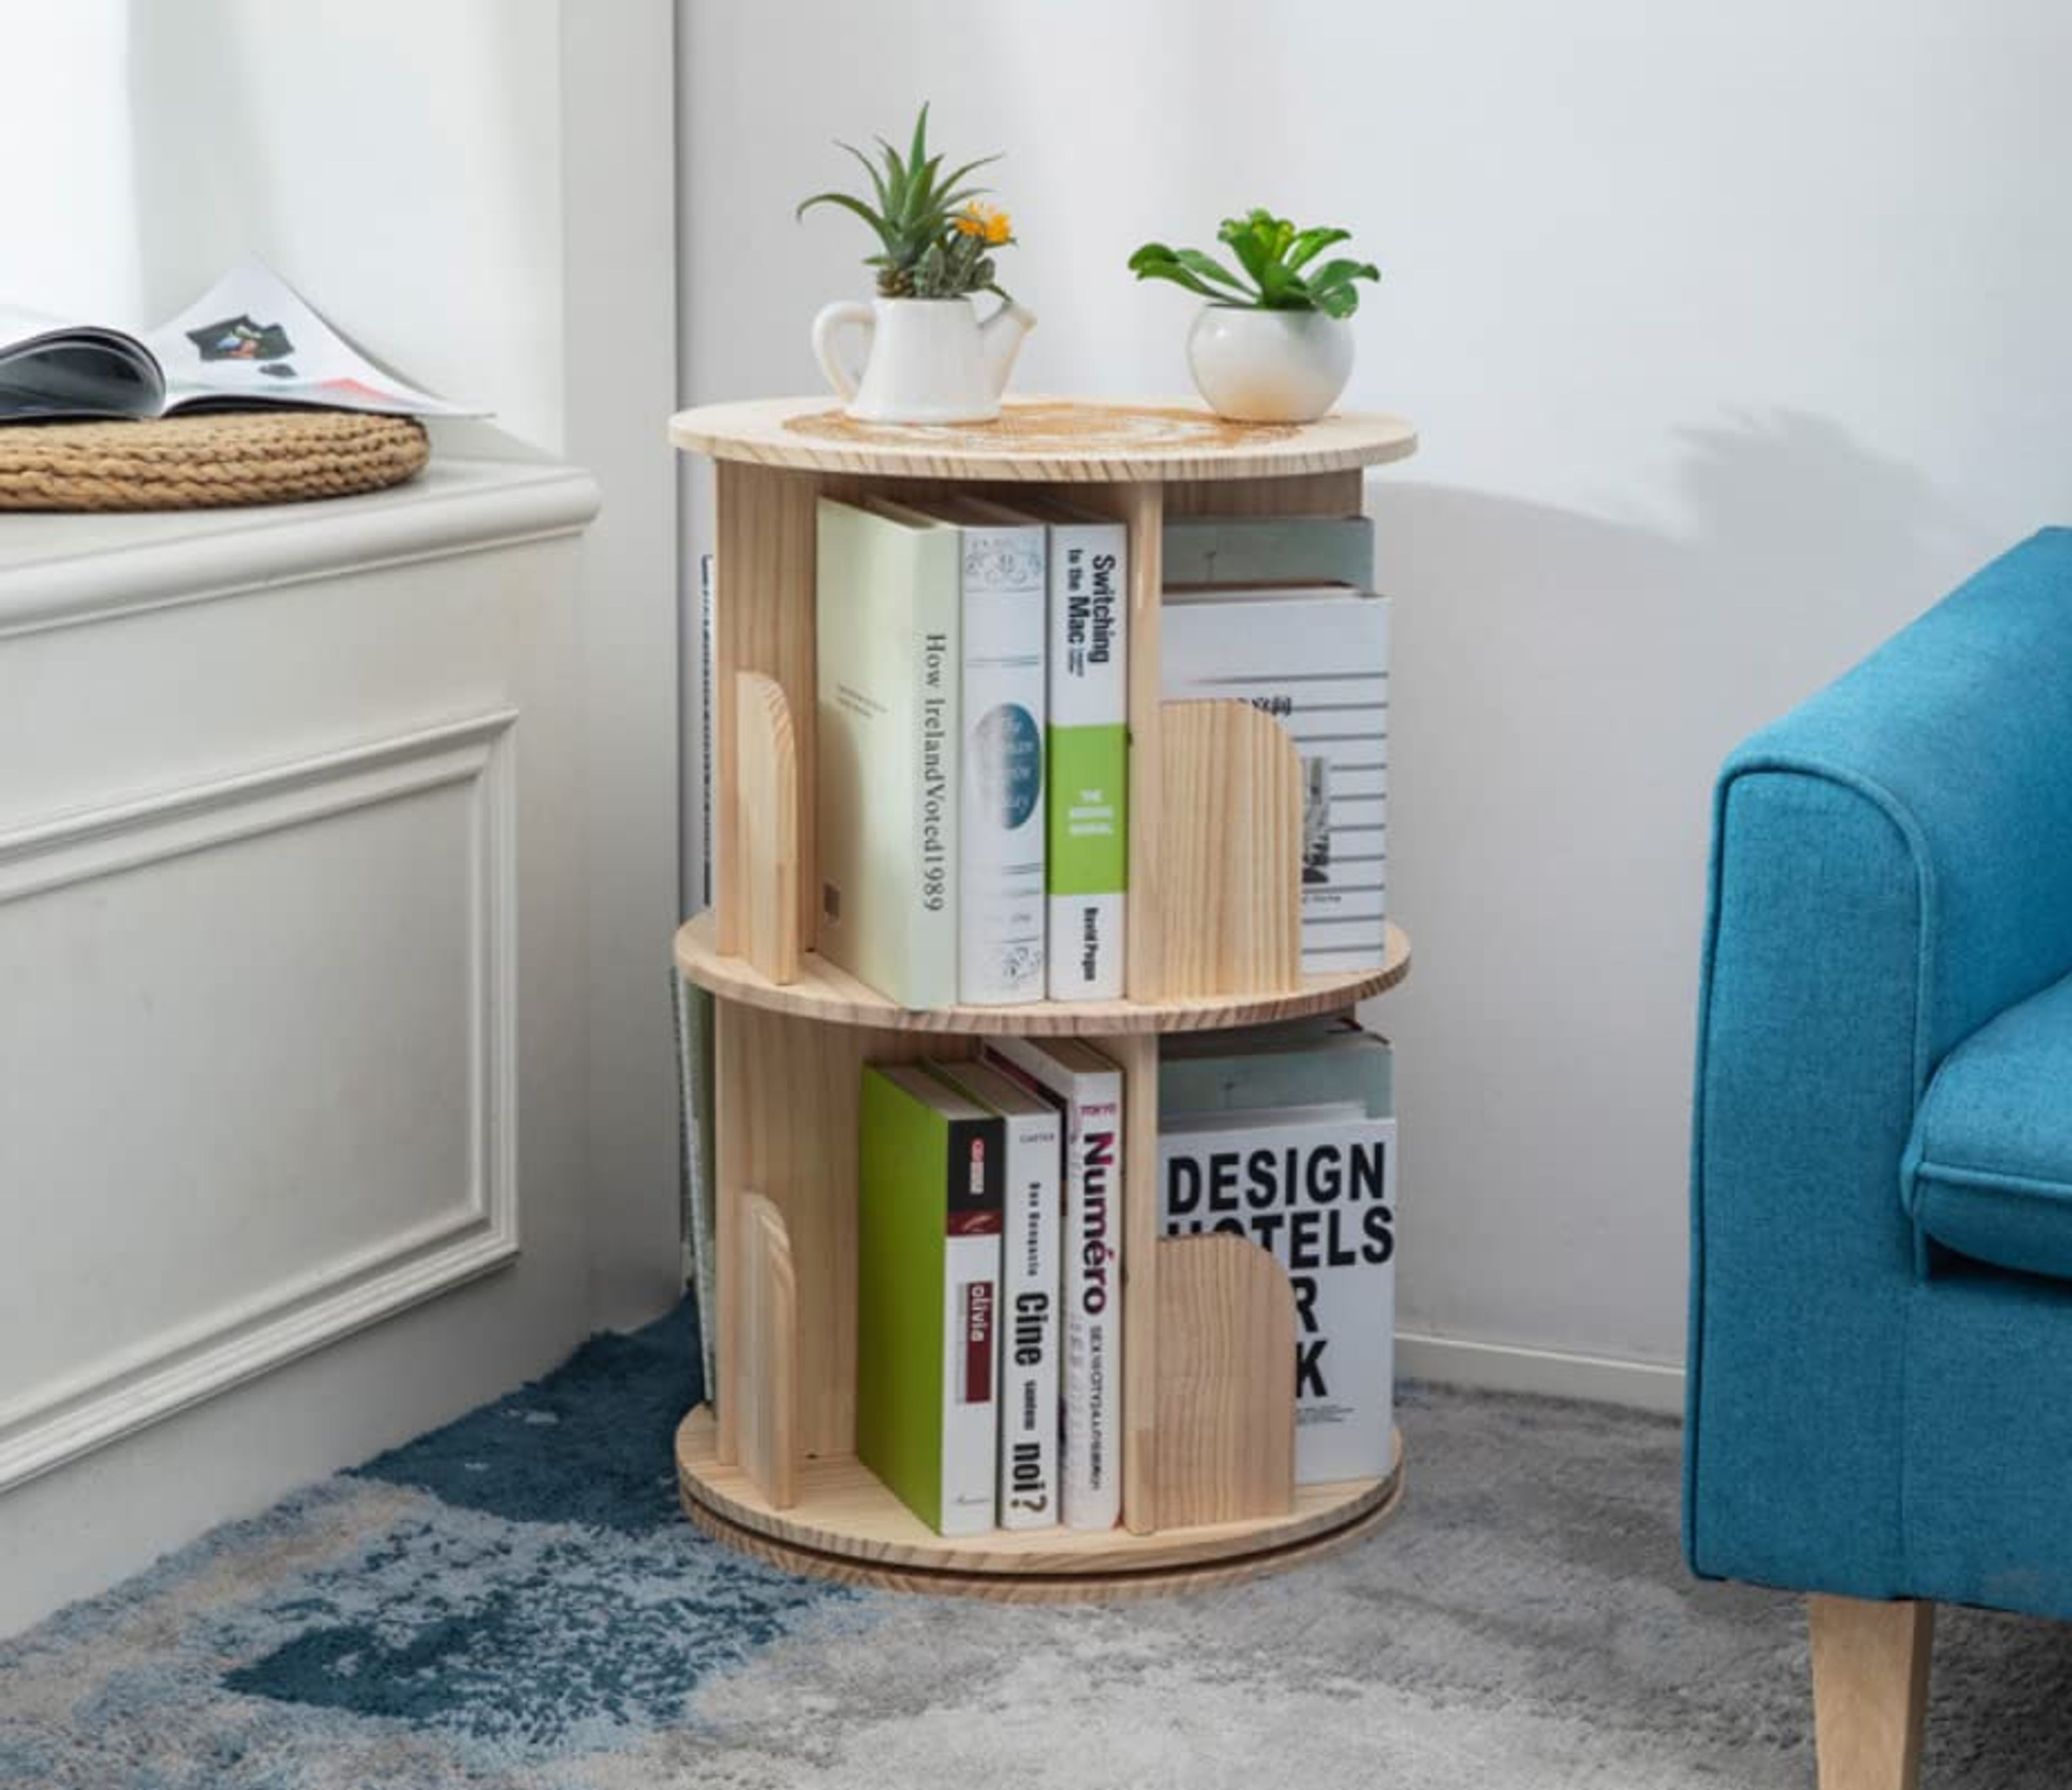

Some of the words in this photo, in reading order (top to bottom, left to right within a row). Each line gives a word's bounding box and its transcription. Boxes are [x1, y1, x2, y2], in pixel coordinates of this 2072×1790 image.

[1068, 596, 1090, 644] Mac
[1086, 554, 1116, 663] Switching
[925, 633, 946, 687] How
[1167, 1142, 1386, 1216] DESIGN
[1083, 1131, 1115, 1315] Numéro
[1167, 1205, 1394, 1269] TELS
[1014, 1292, 1049, 1367] Cine
[1012, 1441, 1048, 1514] noi?
